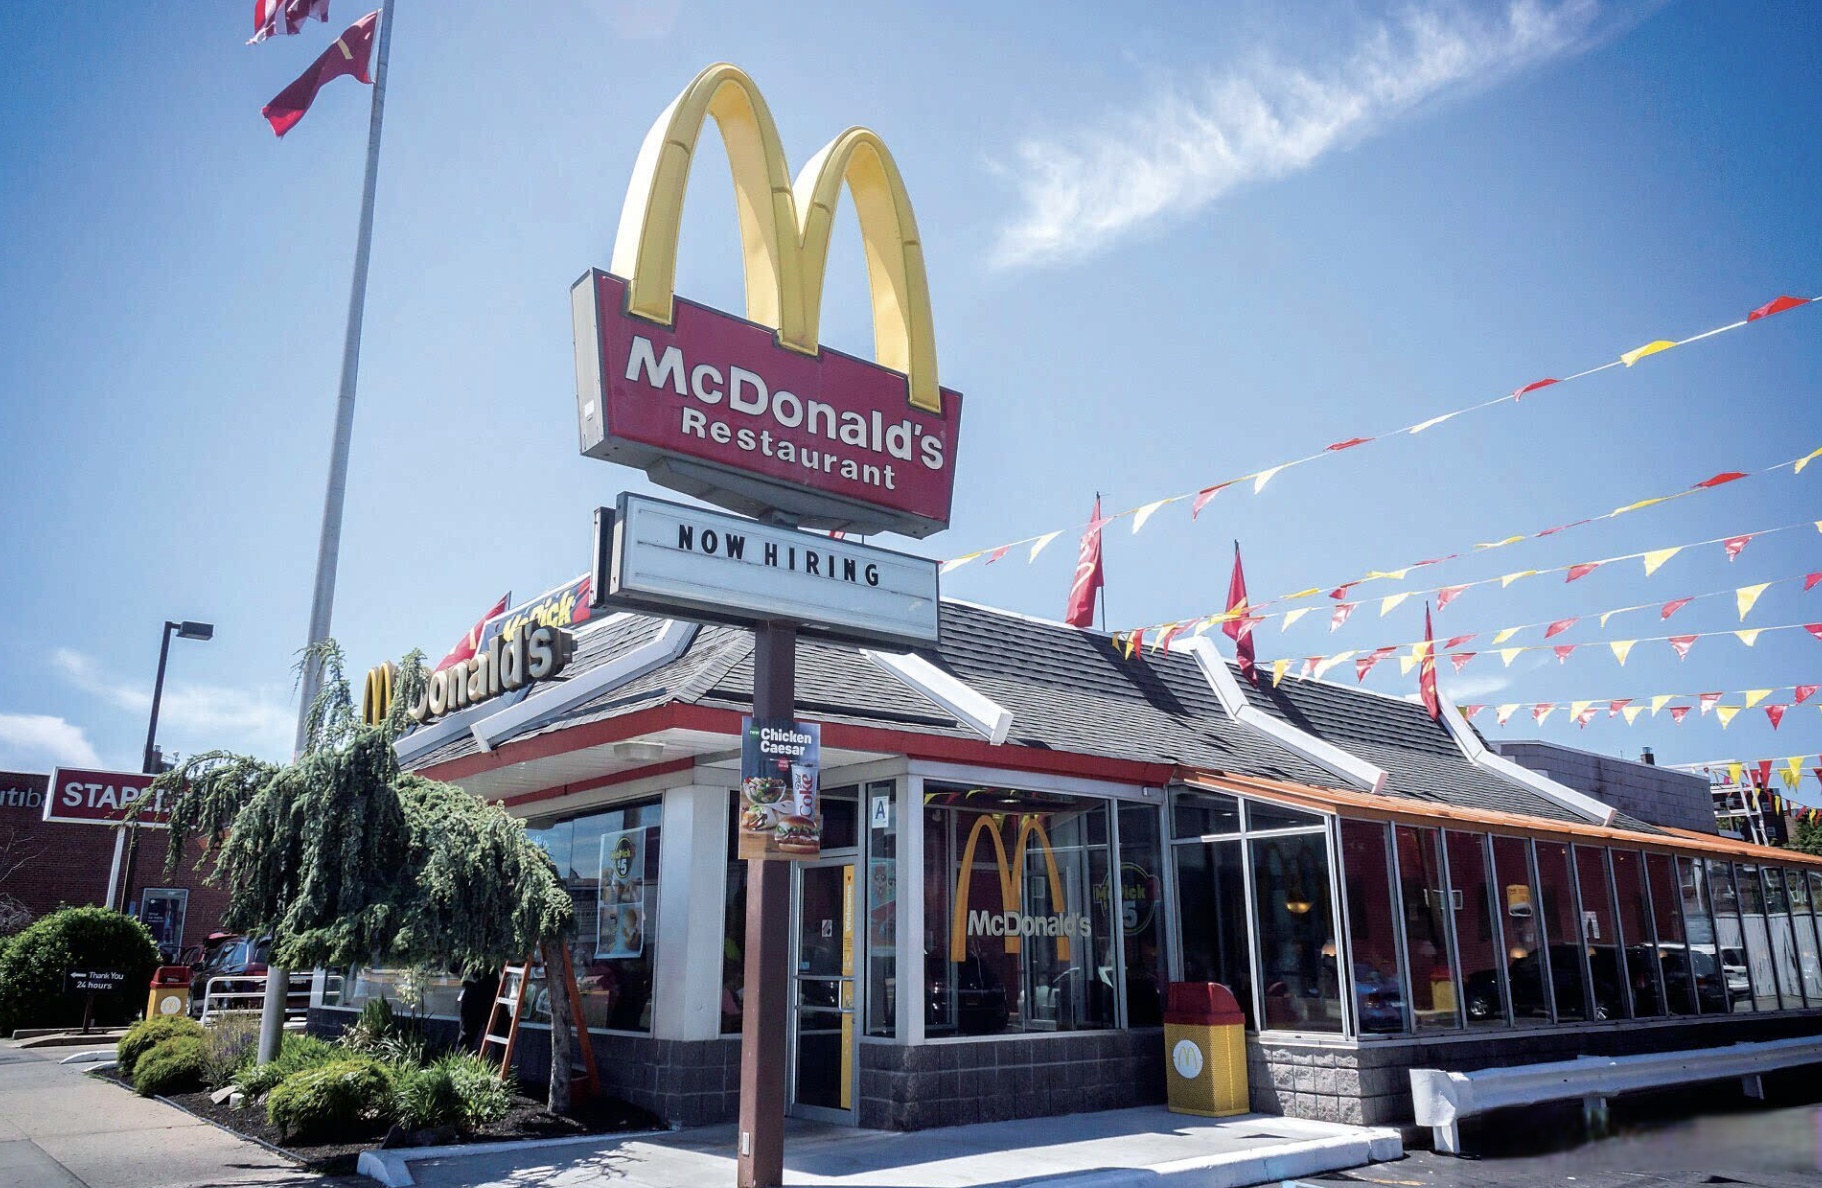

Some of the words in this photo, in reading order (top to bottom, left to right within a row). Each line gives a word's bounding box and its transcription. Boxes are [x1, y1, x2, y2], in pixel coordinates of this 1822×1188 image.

[625, 335, 944, 470] McDonald's
[681, 406, 896, 490] Restaurant
[678, 524, 746, 560] NOW
[764, 542, 879, 587] HIRING
[760, 728, 812, 744] Chicken
[760, 740, 806, 756] Caesar
[799, 774, 813, 817] Coke
[875, 800, 886, 819] A
[967, 909, 1092, 937] McDonald's
[76, 980, 87, 989] 24
[87, 981, 113, 990] hours
[89, 971, 110, 980] Thank
[110, 971, 124, 980] You
